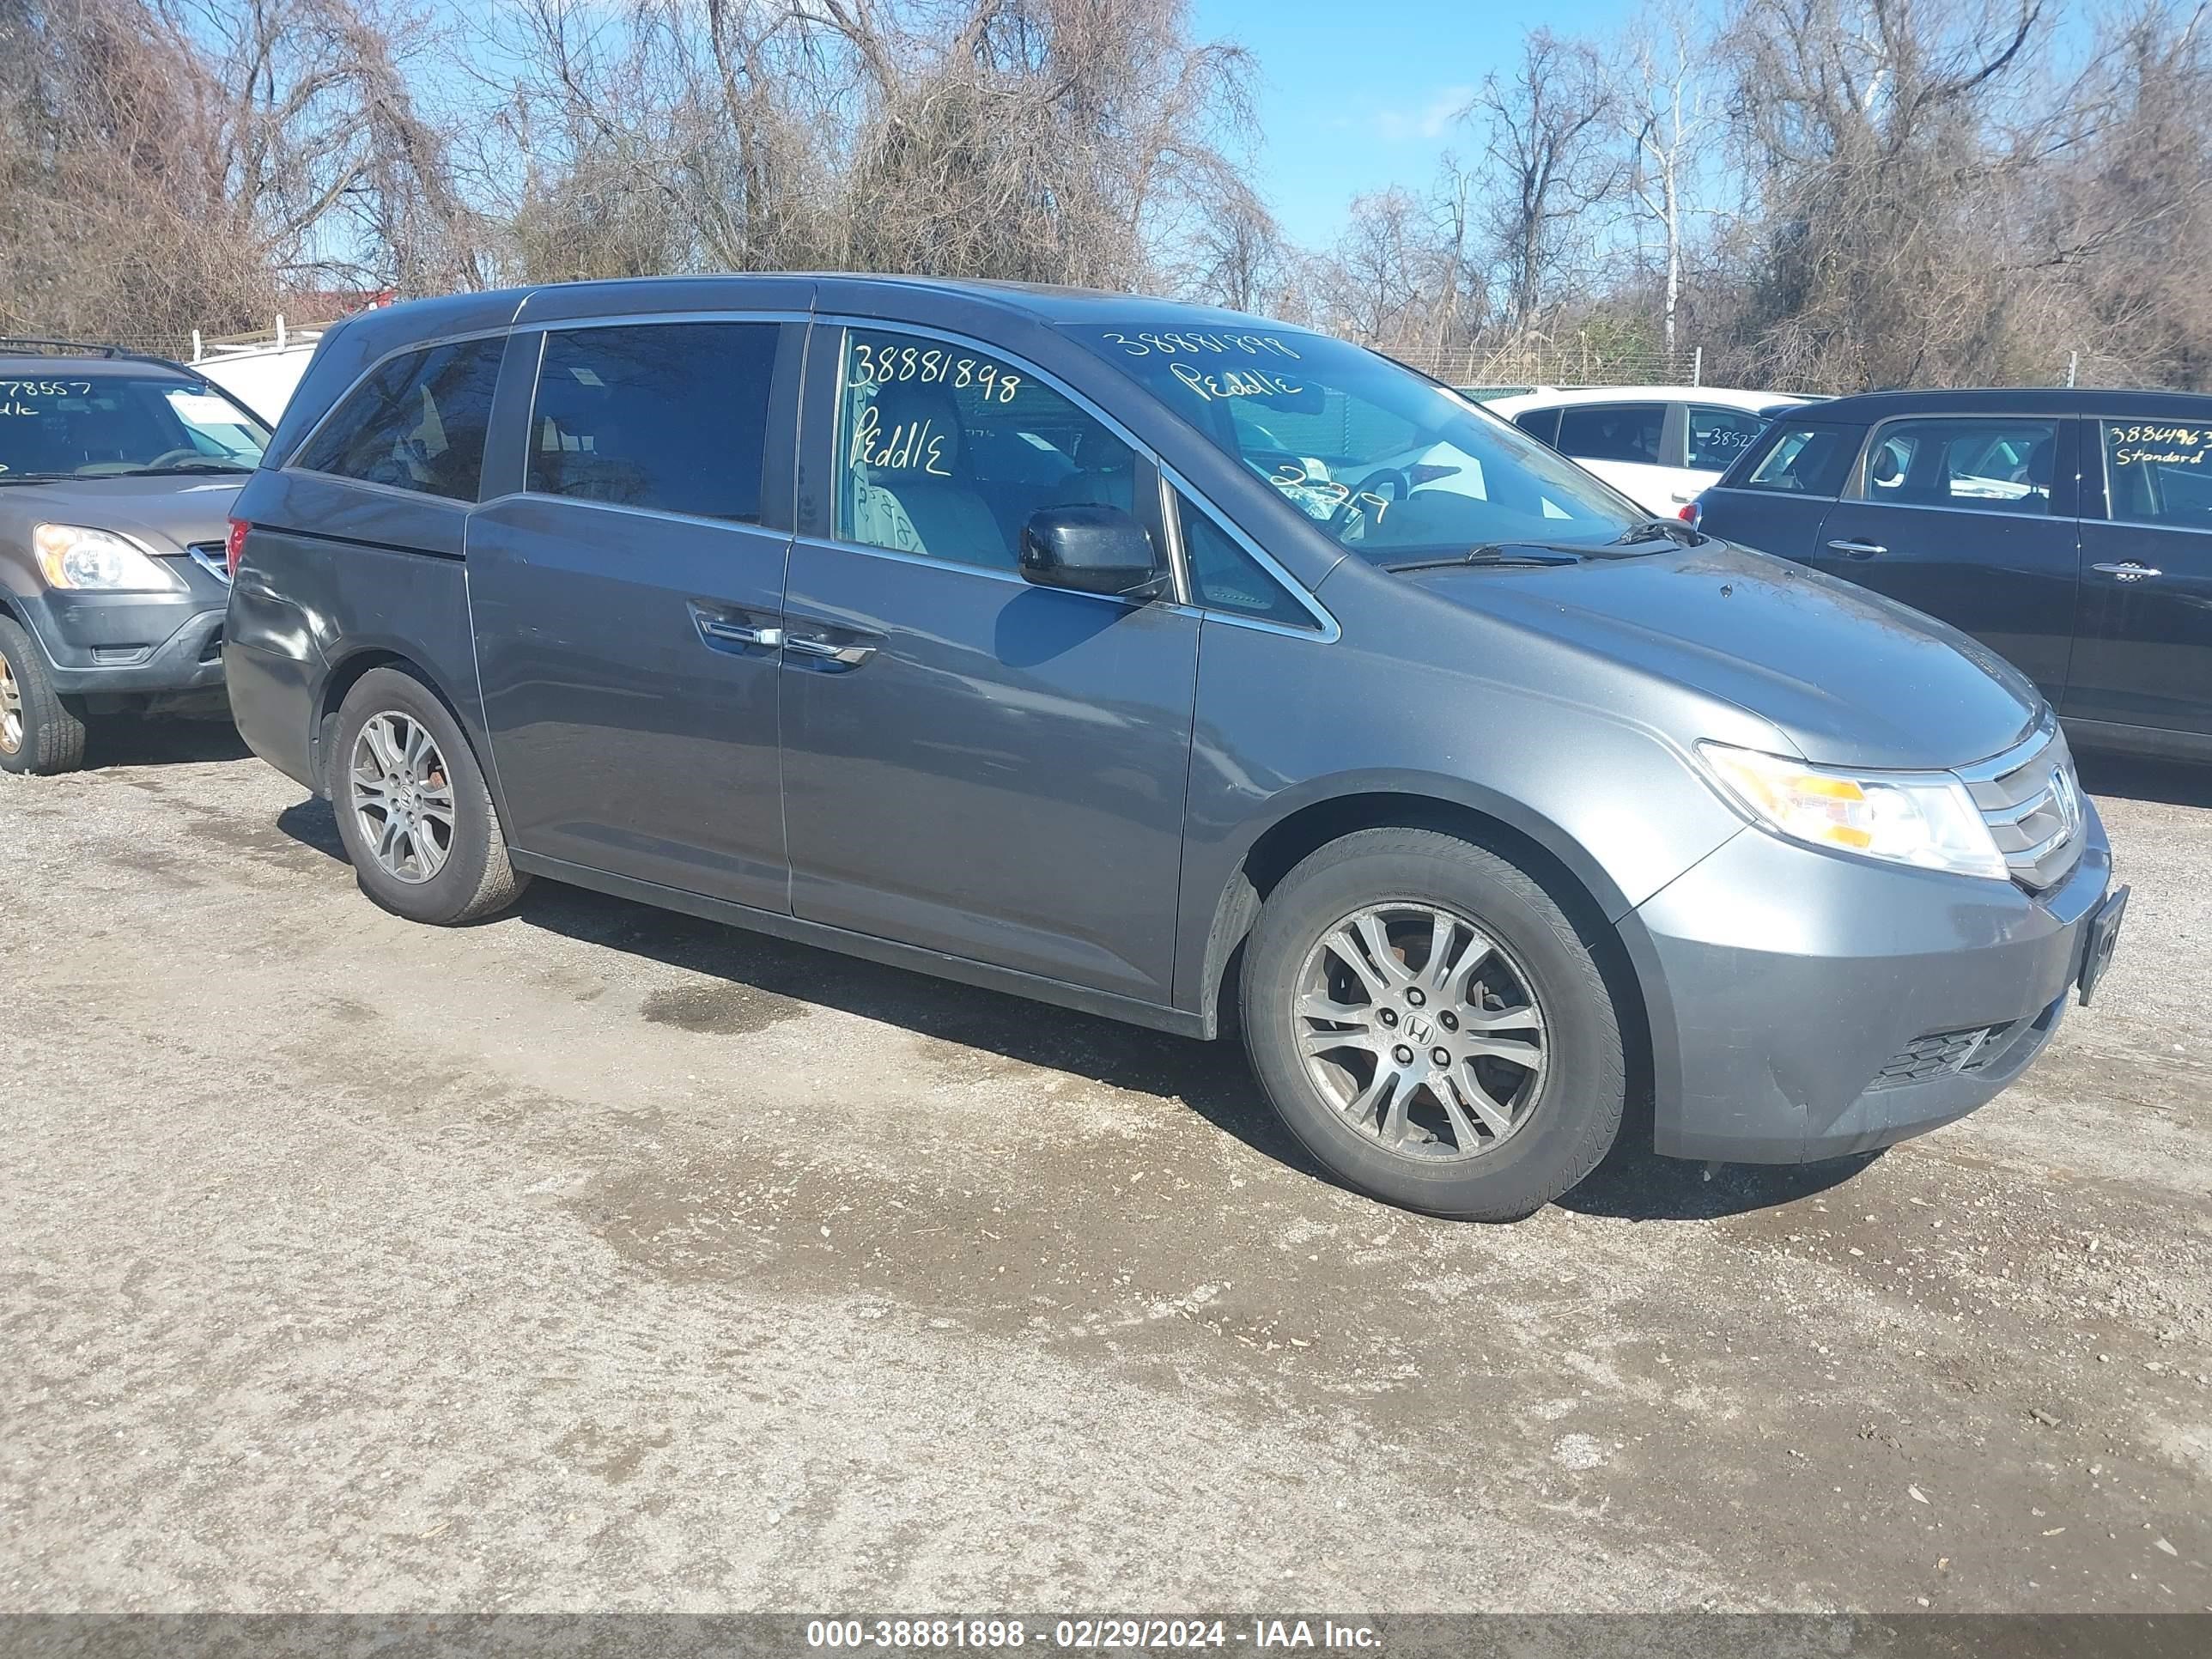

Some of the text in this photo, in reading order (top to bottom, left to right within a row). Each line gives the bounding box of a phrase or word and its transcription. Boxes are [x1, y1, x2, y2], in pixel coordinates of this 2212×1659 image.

[1103, 332, 1301, 359] 38881898
[848, 344, 1022, 403] 38881898
[2116, 448, 2205, 465] Standard
